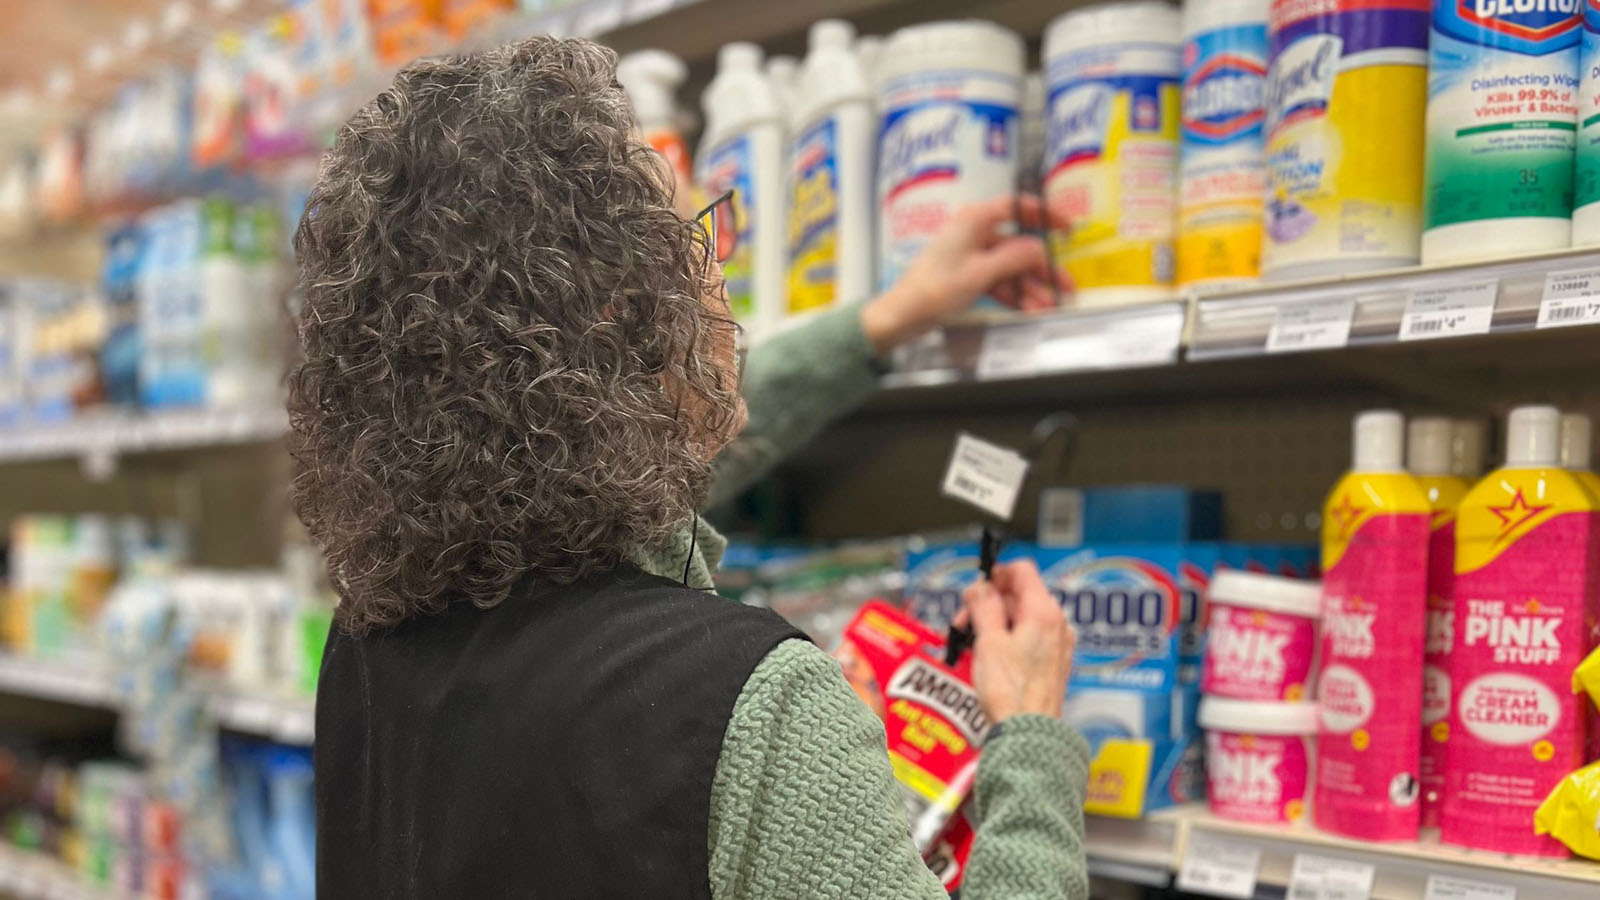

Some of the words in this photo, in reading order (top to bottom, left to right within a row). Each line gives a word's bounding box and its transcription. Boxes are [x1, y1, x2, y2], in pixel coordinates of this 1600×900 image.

[1471, 73, 1550, 92] Disinfecting
[1486, 94, 1514, 105] Kills
[1517, 89, 1558, 103] 99.9%
[1467, 599, 1505, 616] THE
[1464, 616, 1563, 648] PINK
[1208, 625, 1290, 664] INK
[1493, 645, 1562, 665] STUFF
[899, 664, 989, 735] AMDRO
[1474, 694, 1539, 711] CREAM
[1464, 707, 1550, 727] CLEANER
